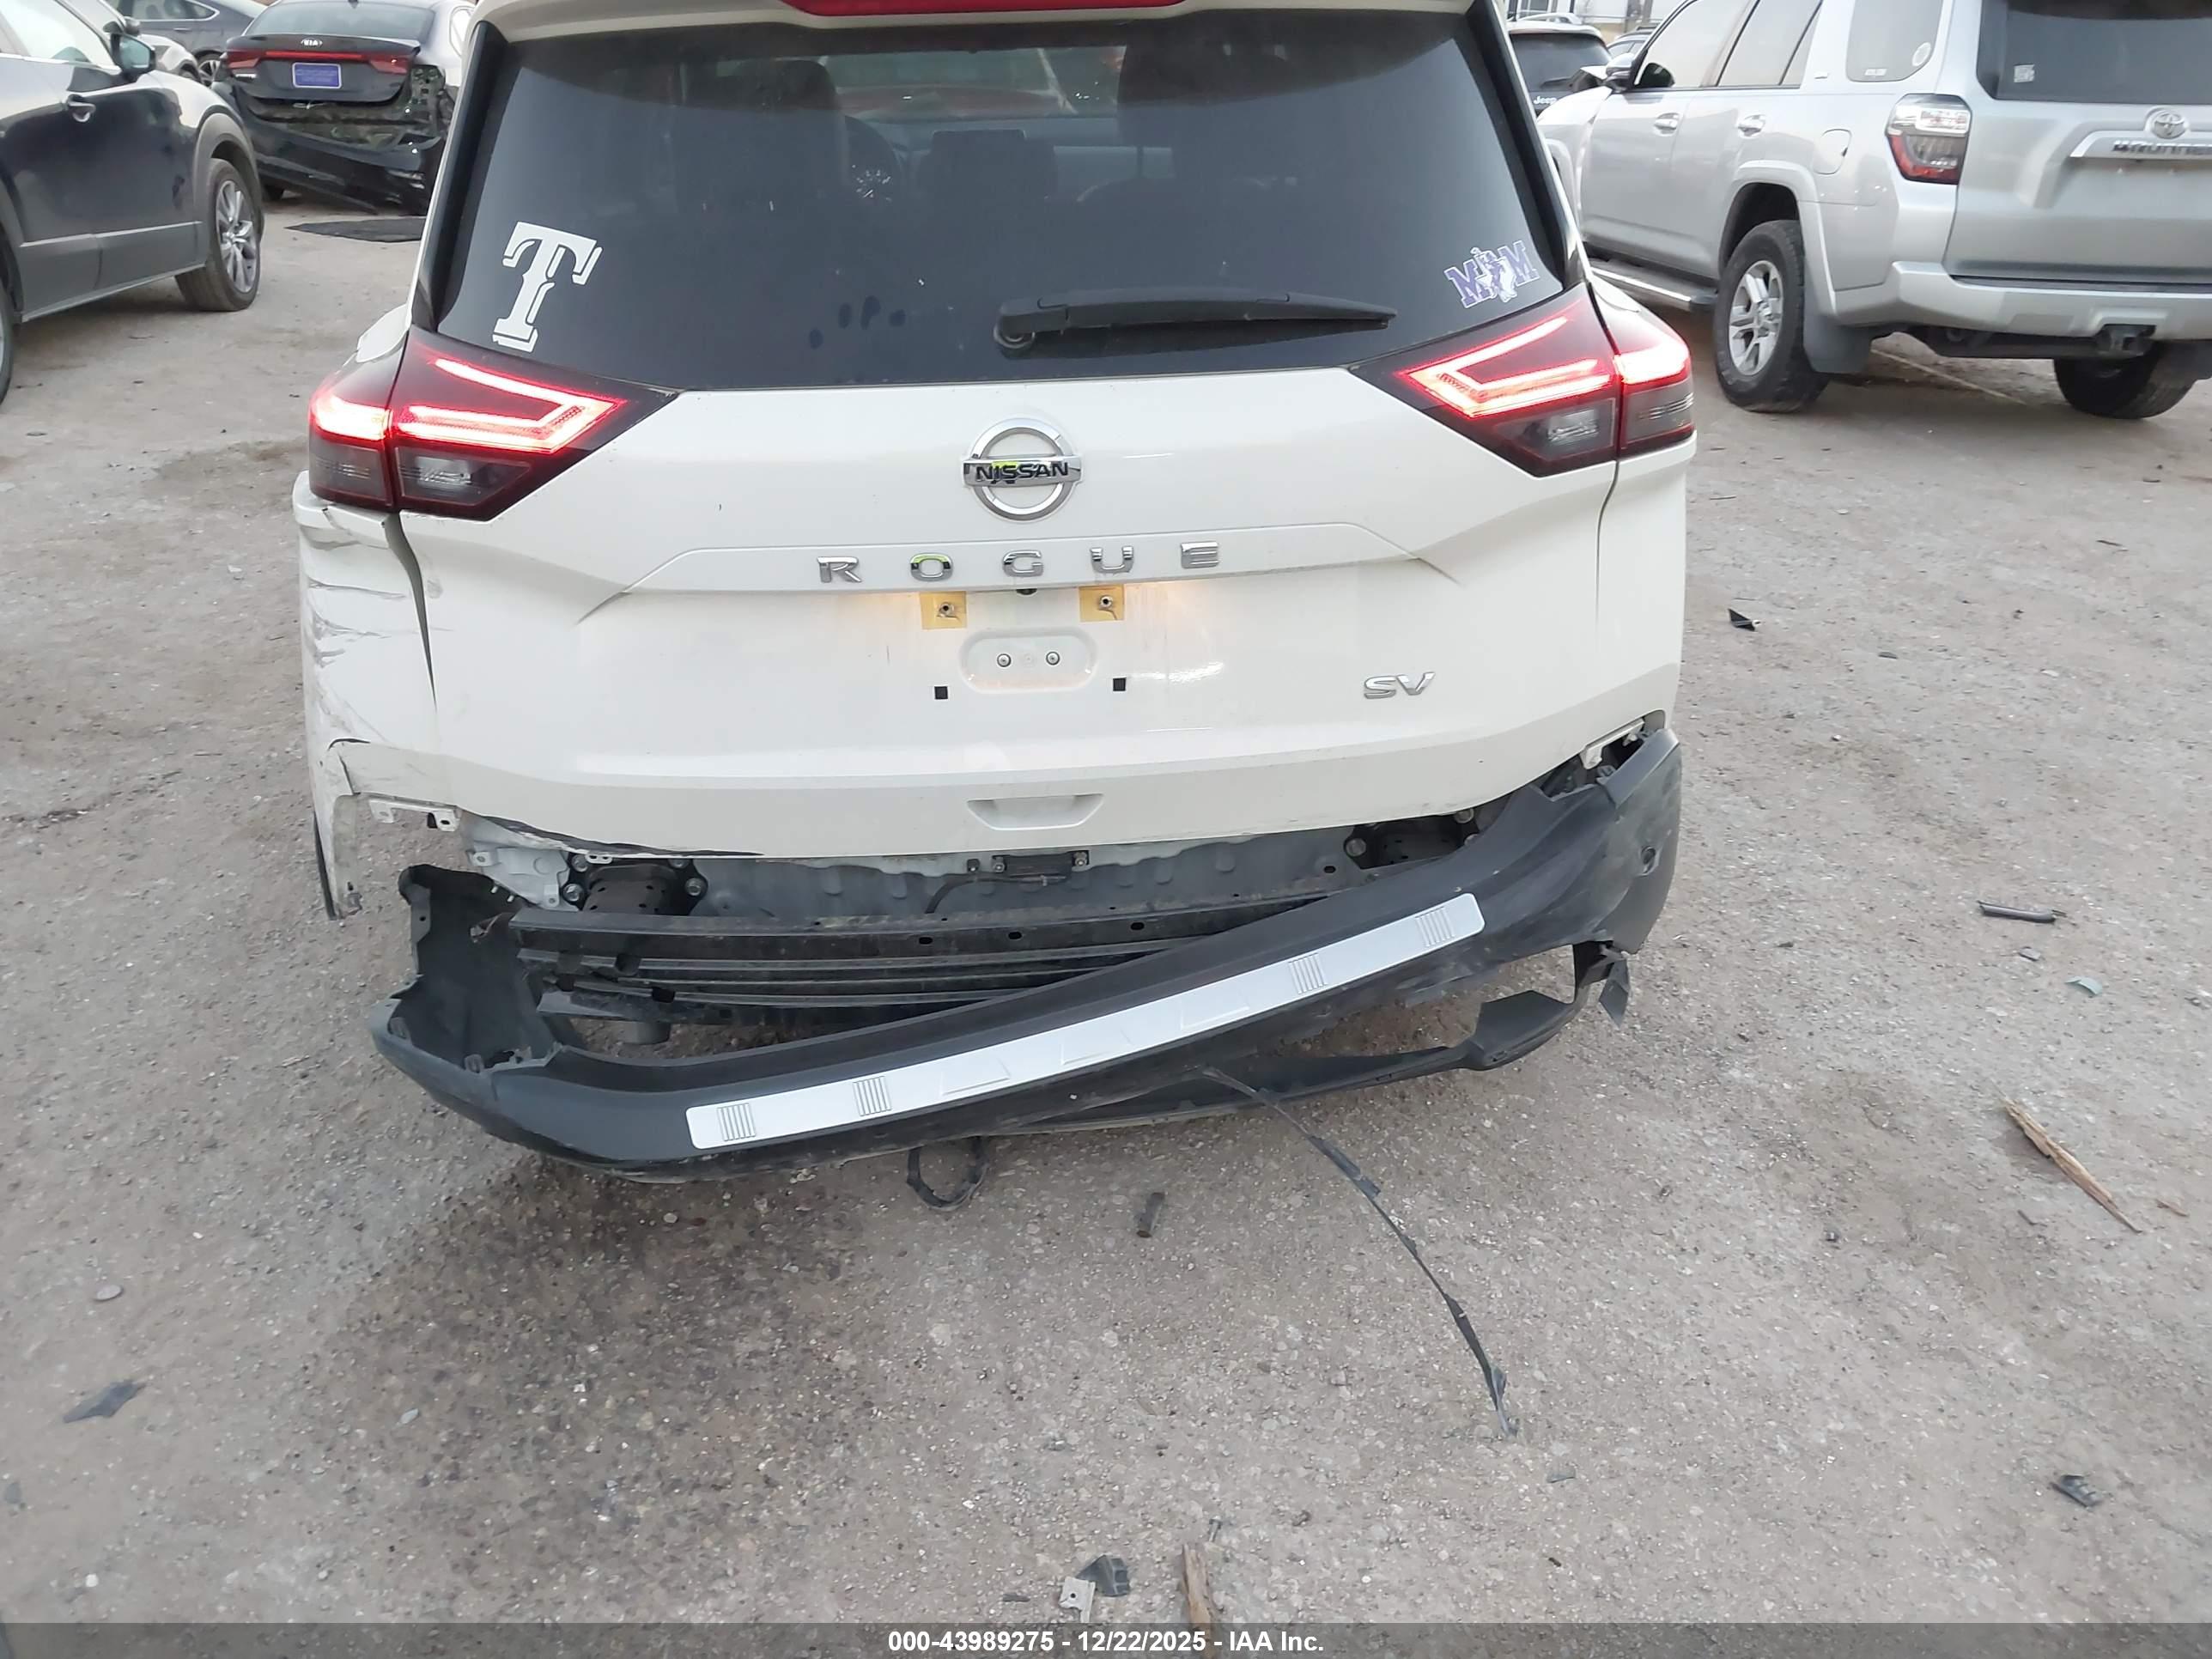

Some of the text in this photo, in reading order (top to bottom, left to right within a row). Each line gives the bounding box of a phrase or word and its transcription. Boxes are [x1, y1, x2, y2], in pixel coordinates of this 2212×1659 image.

[1533, 95, 1558, 106] Jeep
[492, 221, 604, 353] T
[975, 461, 1069, 482] NISSAN
[817, 540, 1221, 584] ROGUE
[1363, 671, 1437, 700] SV
